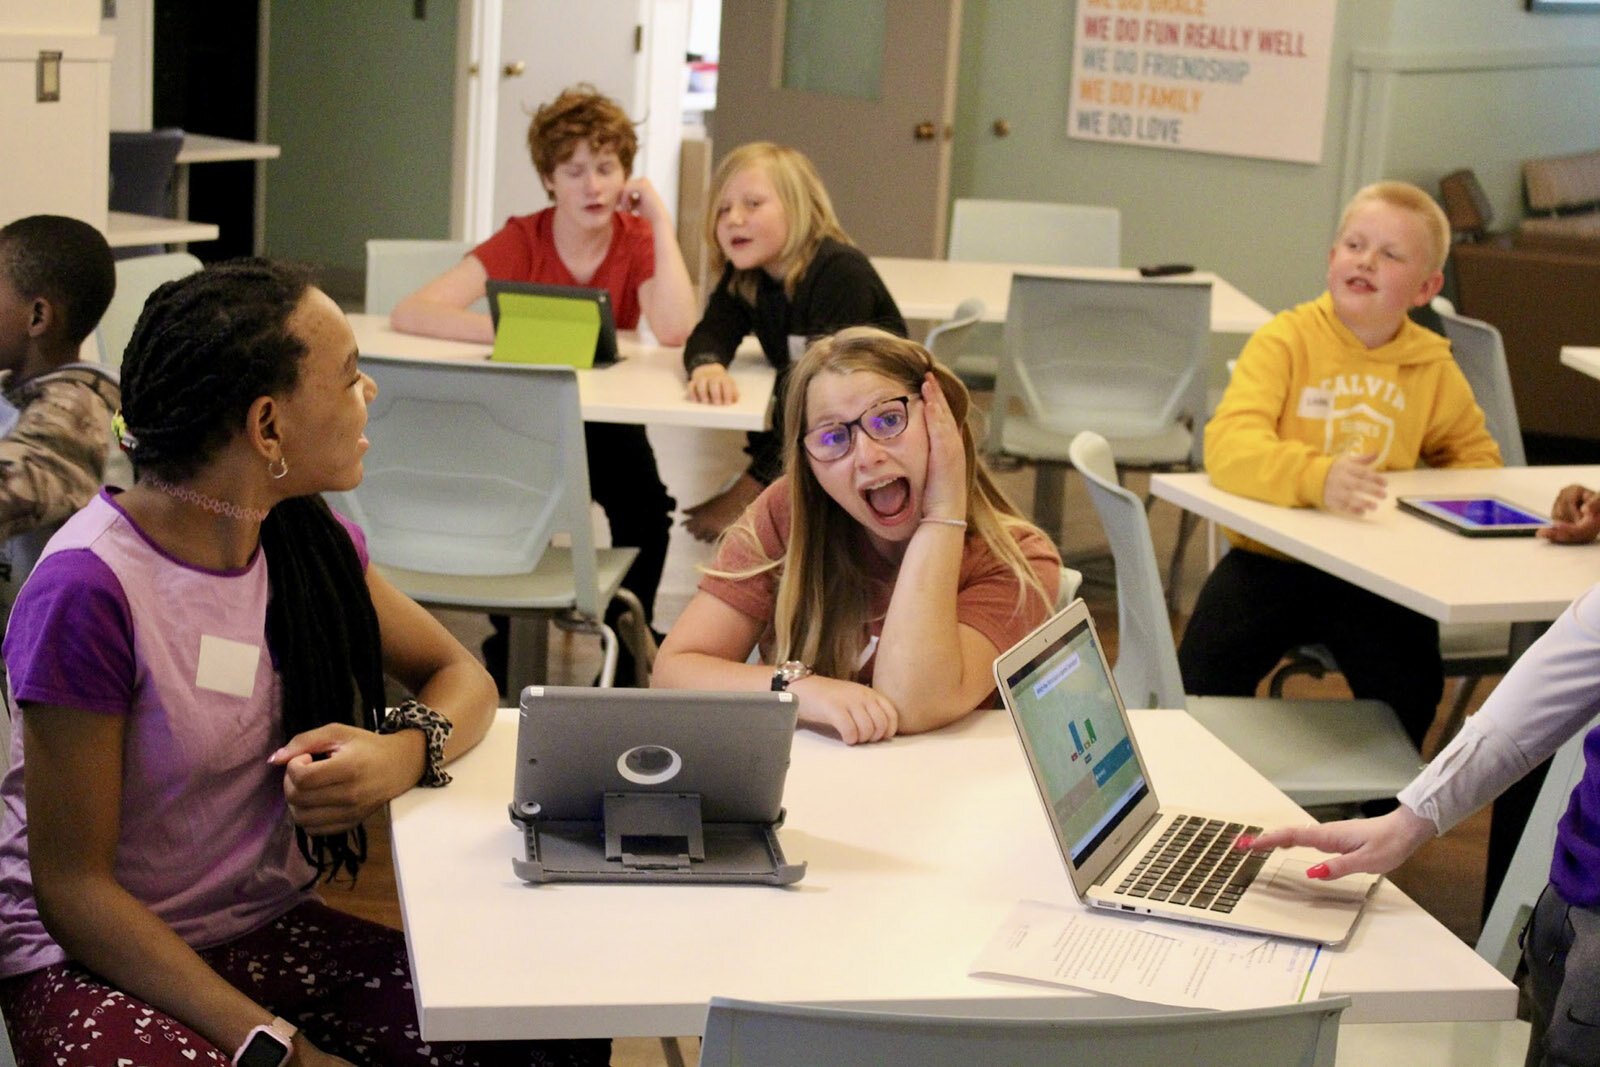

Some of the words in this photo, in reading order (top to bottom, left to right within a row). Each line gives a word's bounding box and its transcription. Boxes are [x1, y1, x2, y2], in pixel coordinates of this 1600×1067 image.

[1084, 17, 1110, 41] WE
[1114, 17, 1140, 43] DO
[1144, 19, 1180, 46] FUN
[1184, 22, 1252, 51] REALLY
[1258, 28, 1307, 58] WELL
[1082, 47, 1107, 72] WE
[1113, 50, 1139, 74] DO
[1142, 52, 1251, 84] FRIENDSHIP
[1079, 78, 1105, 103] WE
[1109, 80, 1135, 106] DO
[1139, 83, 1202, 113] FAMILY
[1077, 110, 1101, 135] WE
[1106, 112, 1133, 138] DO
[1138, 115, 1181, 143] LOVE
